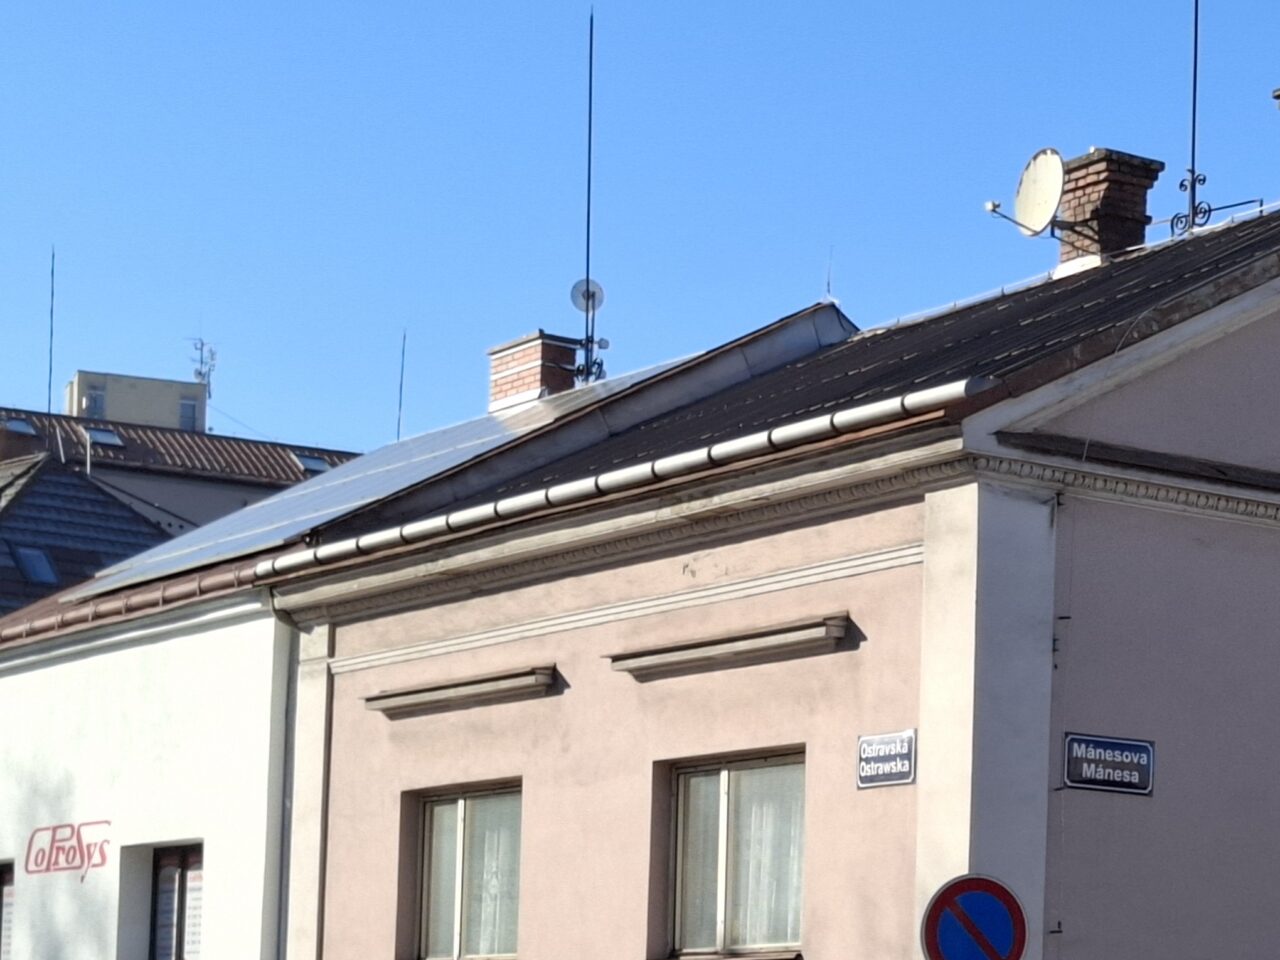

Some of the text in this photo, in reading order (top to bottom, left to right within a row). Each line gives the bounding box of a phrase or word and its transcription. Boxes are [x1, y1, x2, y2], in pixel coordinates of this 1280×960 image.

[1072, 742, 1148, 765] Mánesova
[859, 756, 910, 777] Ostrawska
[1081, 762, 1140, 783] Mánesa
